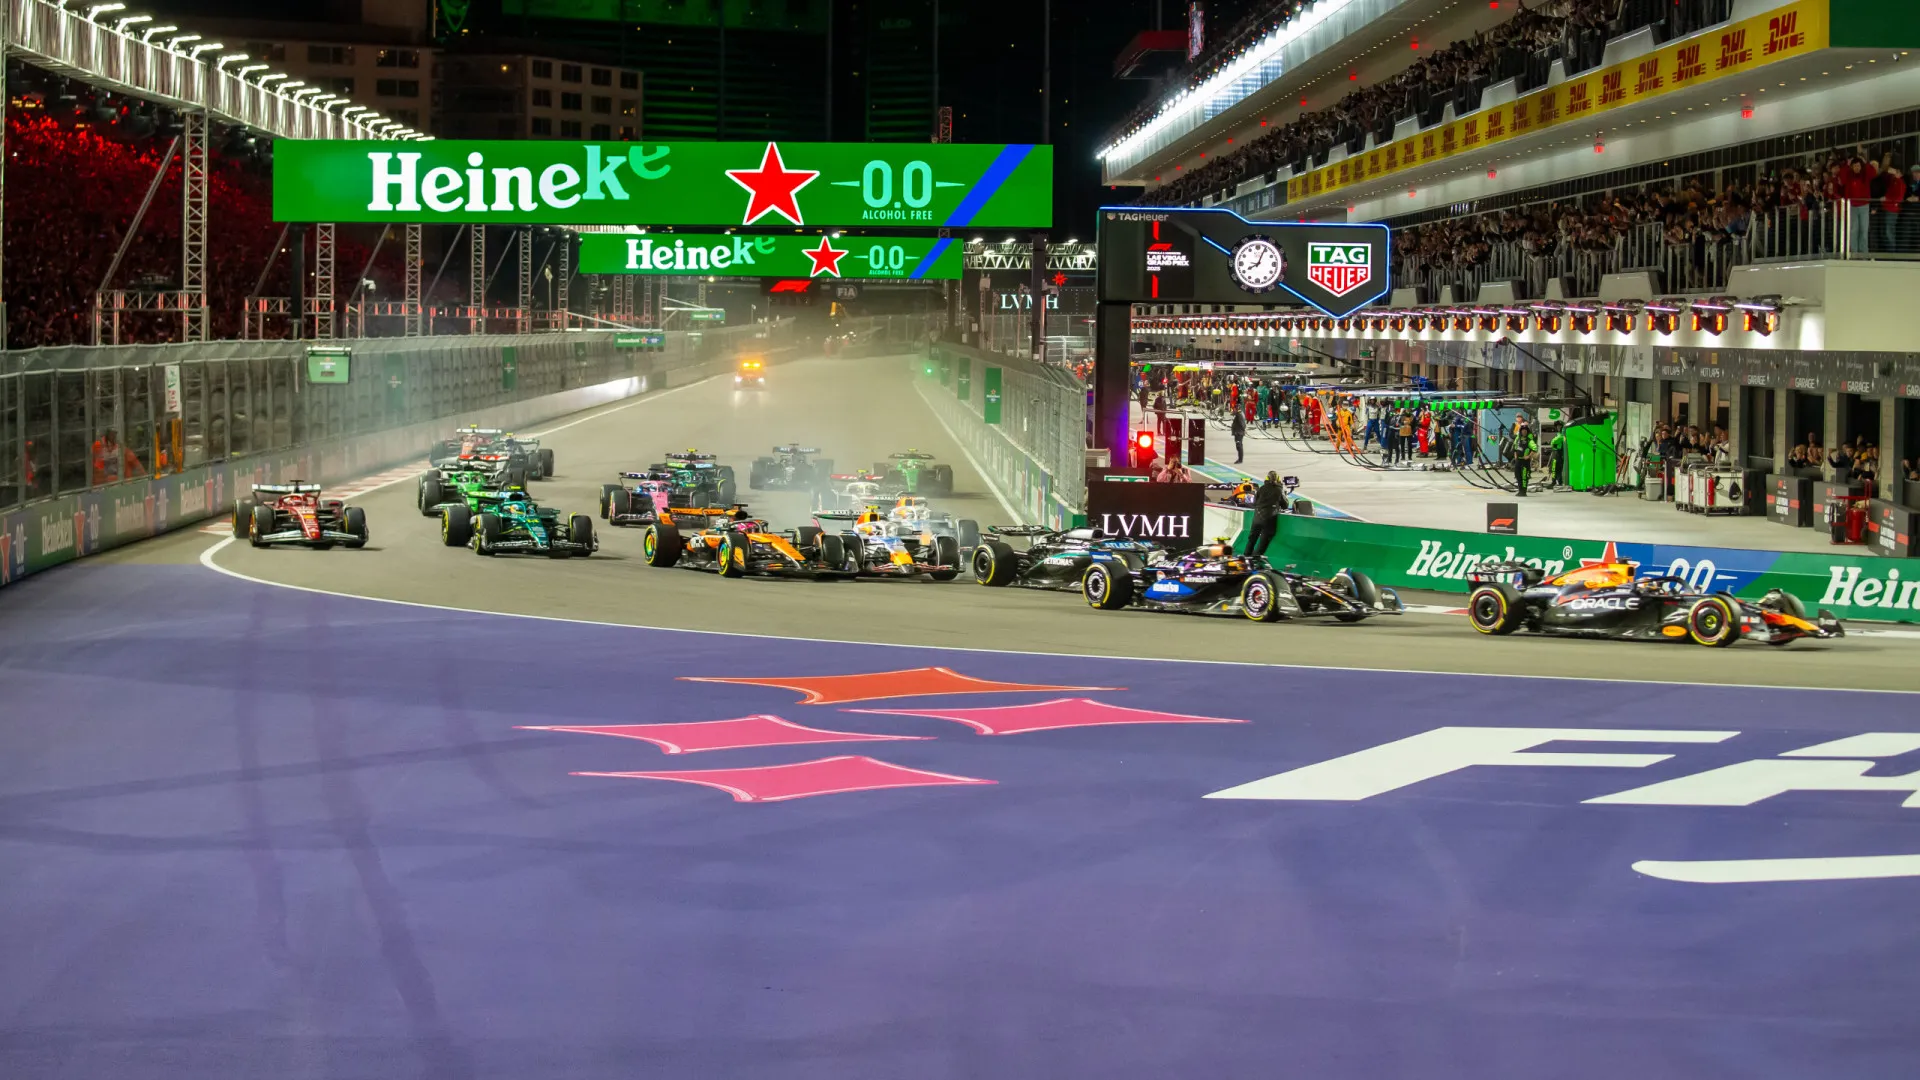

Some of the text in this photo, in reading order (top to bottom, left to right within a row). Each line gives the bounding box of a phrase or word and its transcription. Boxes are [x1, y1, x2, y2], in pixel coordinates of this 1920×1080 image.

[1767, 11, 1799, 54] DHL
[1719, 29, 1748, 69] DHL
[1676, 44, 1702, 82] DHL
[1601, 71, 1623, 105] DHL
[1637, 58, 1660, 94] DHL
[862, 160, 933, 208] 0.0
[862, 210, 933, 220] ALCOHOL FREE
[869, 245, 904, 269] 0.0
[1313, 246, 1365, 263] TAG
[837, 287, 855, 296] FIA
[1312, 267, 1367, 292] HEUER
[1794, 377, 1815, 388] GARAGE
[1846, 380, 1870, 393] GARAGE
[1102, 513, 1190, 538] LVMH
[1571, 597, 1641, 611] ORACLE
